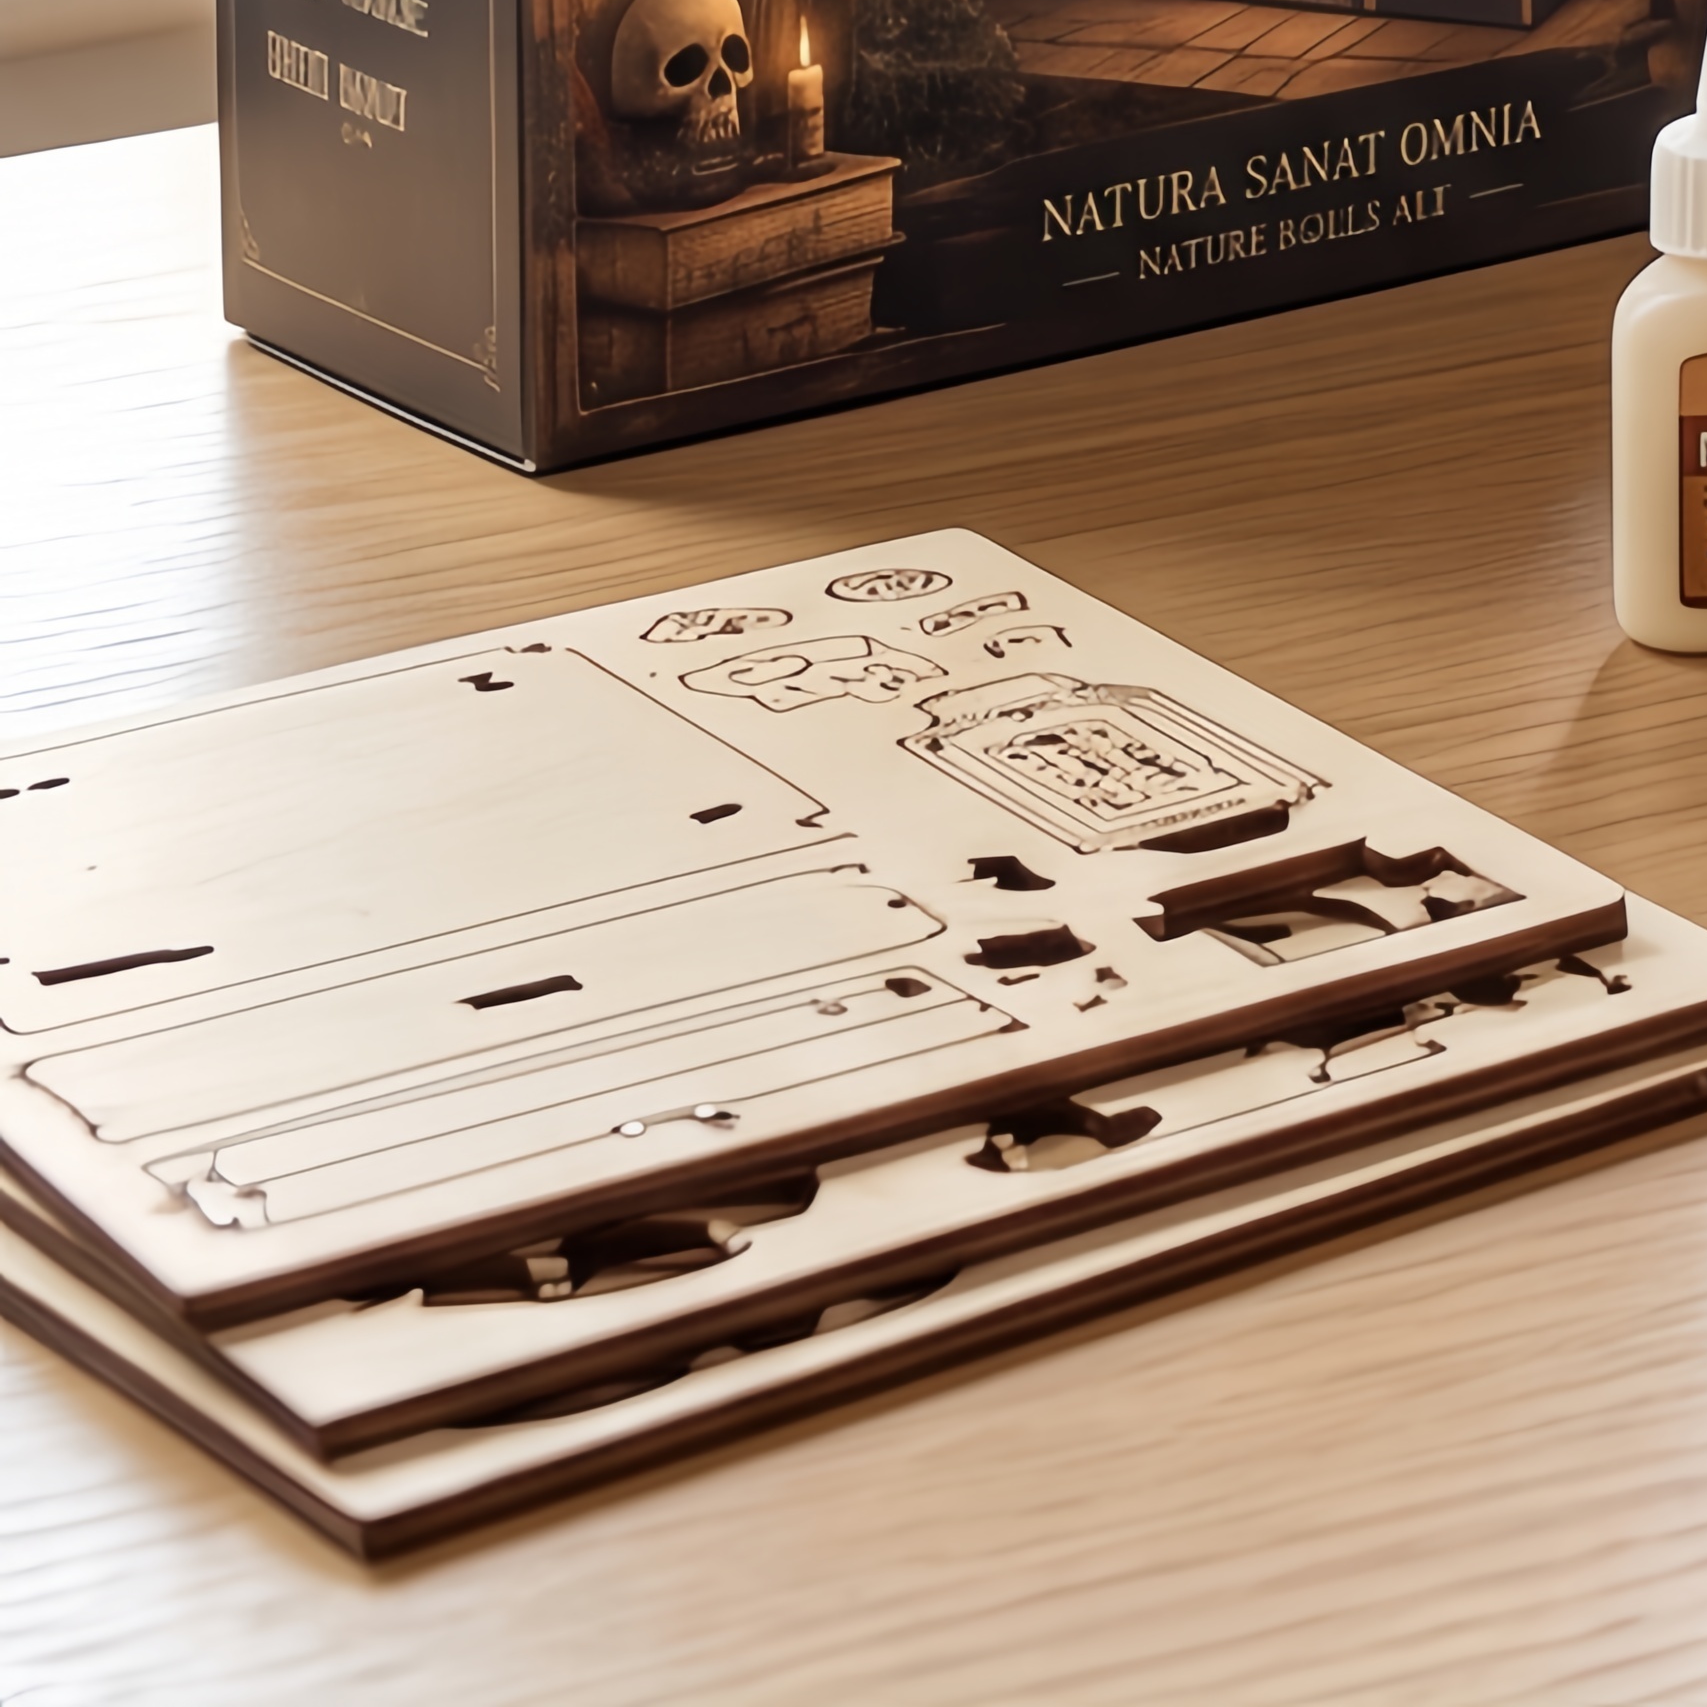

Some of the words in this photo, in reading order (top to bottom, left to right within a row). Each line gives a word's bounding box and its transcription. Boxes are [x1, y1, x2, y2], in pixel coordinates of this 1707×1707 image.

[1042, 166, 1227, 242] NATURA
[1245, 130, 1386, 201] SANAT
[1400, 100, 1542, 166] OMNIA
[1138, 224, 1268, 280] NATURE
